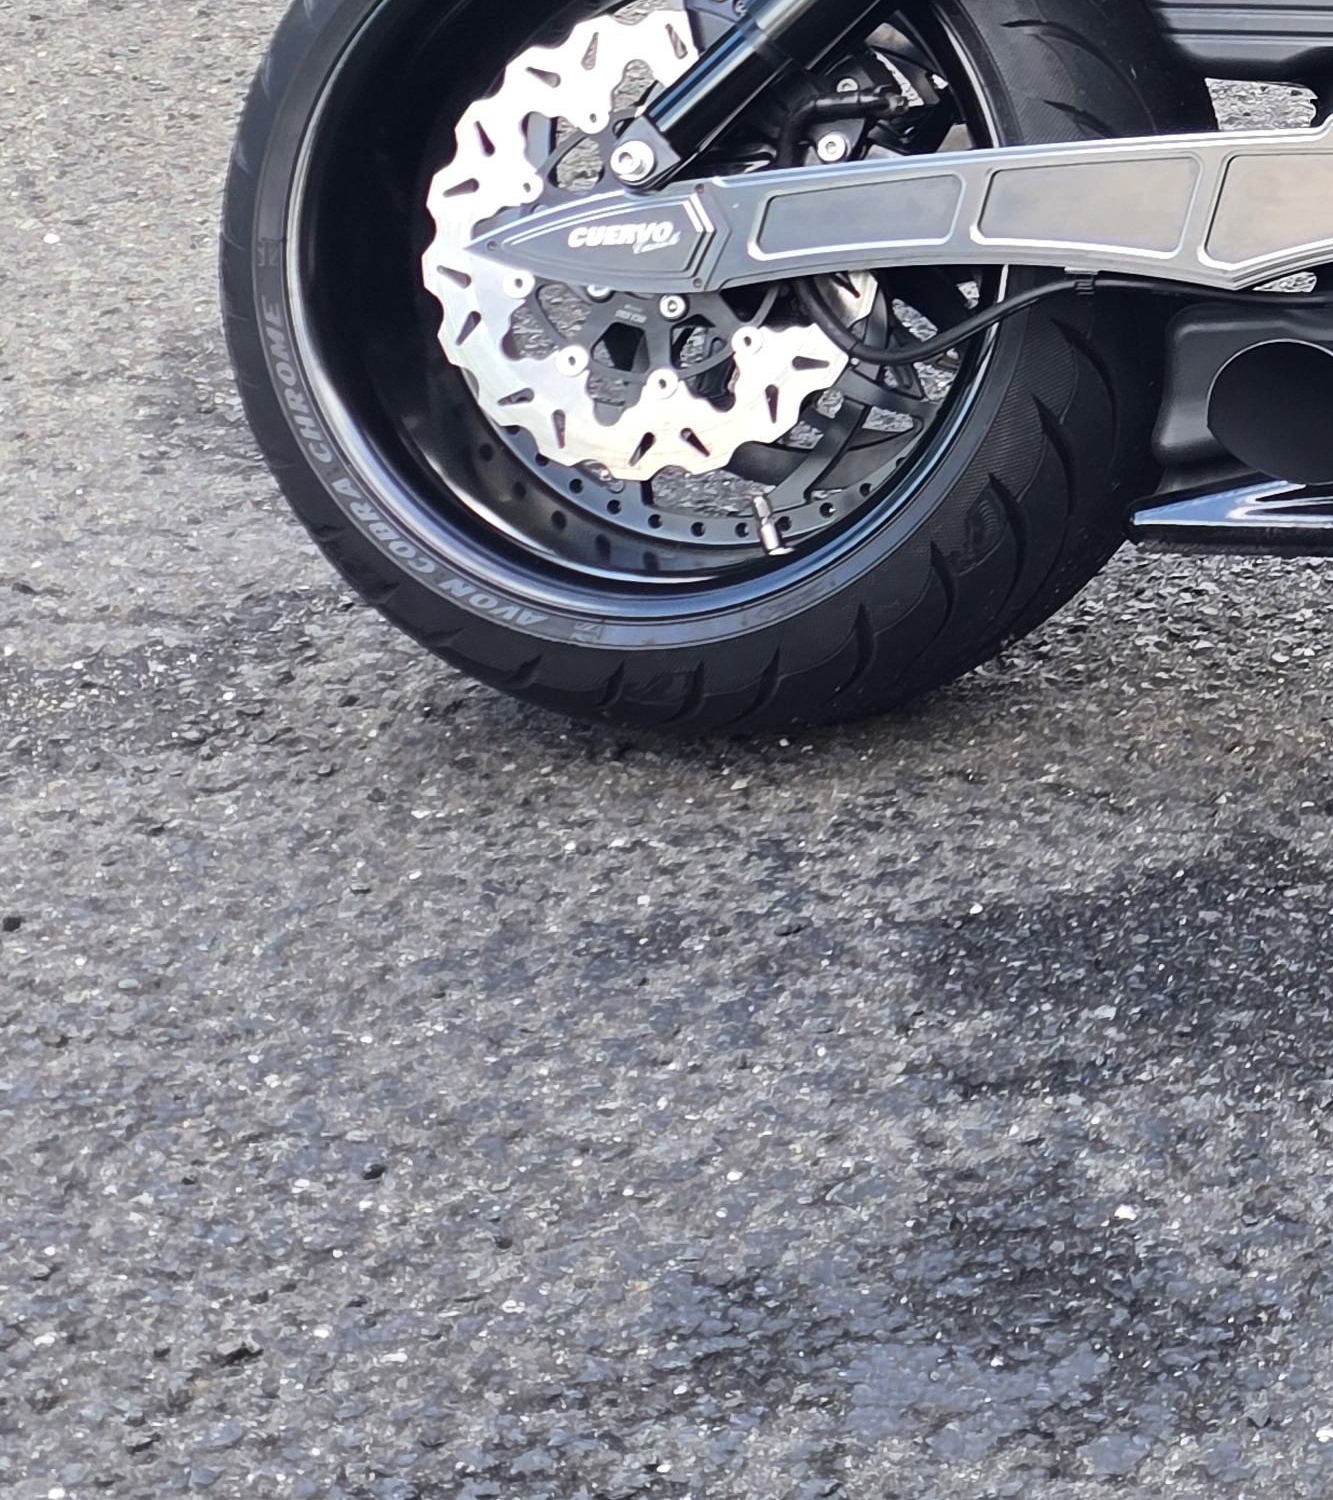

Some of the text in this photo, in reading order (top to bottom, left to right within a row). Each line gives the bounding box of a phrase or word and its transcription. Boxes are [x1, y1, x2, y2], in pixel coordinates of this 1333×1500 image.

[567, 221, 675, 248] CUERVO
[261, 294, 549, 626] AVON COBRA CHROME
